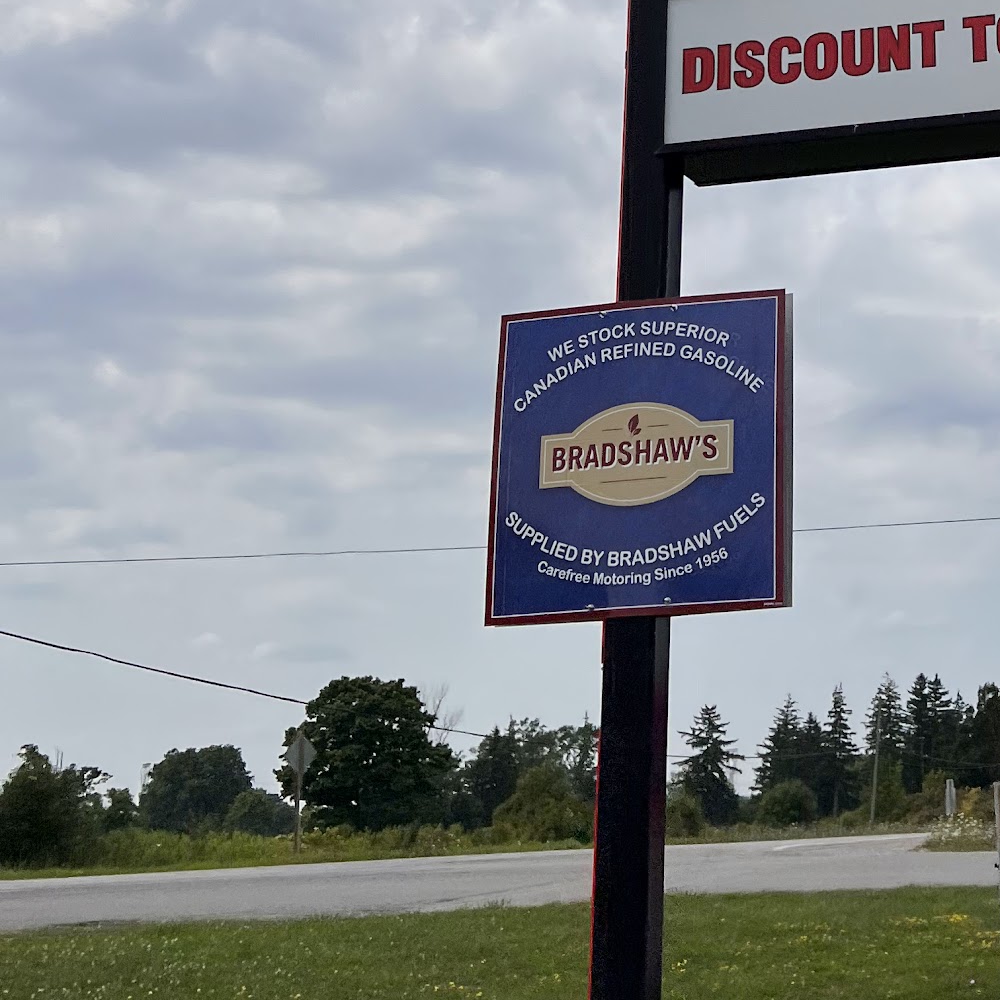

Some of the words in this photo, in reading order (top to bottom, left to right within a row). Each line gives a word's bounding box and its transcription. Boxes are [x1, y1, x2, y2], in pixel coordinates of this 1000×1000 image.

[682, 20, 945, 95] DISCOUNT
[547, 340, 574, 363] WE
[577, 322, 636, 349] STOCK
[640, 321, 730, 347] SUPERIOR
[513, 352, 597, 413] CANADIAN
[600, 341, 676, 363] REFINED
[679, 344, 765, 393] GASOLINE
[552, 434, 719, 473] BRADSHAW'S
[504, 511, 578, 562] SUPPLIED
[580, 549, 604, 567] BY
[607, 529, 712, 567] BRADSHAW
[713, 492, 766, 540] FUELS
[537, 560, 590, 584] Carefree
[593, 566, 651, 586] Motoring
[654, 560, 693, 581] Since
[695, 547, 729, 571] 1956
